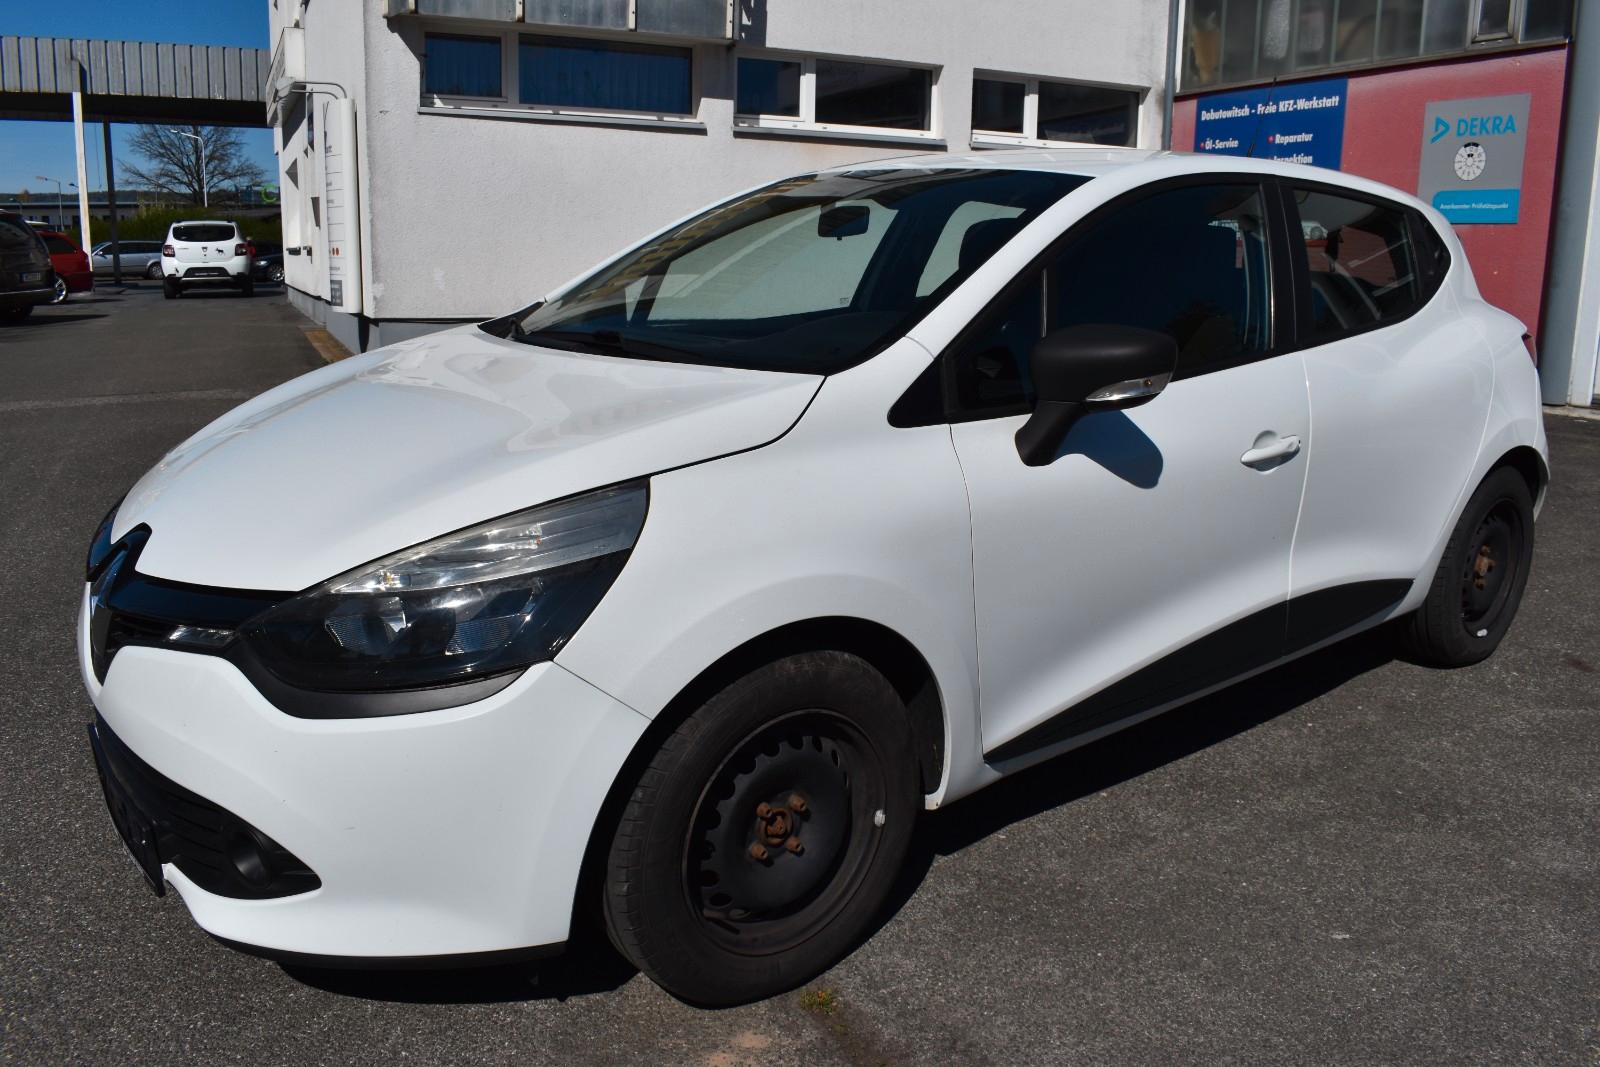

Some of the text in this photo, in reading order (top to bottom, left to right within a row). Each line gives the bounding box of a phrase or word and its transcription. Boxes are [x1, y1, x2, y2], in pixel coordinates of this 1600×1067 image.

[1257, 101, 1277, 115] Freie
[1278, 95, 1340, 112] KFZ-Werkstatt
[1457, 114, 1516, 137] DEKRA
[1205, 138, 1239, 150] Öl-Service
[1275, 133, 1313, 145] Reparatur
